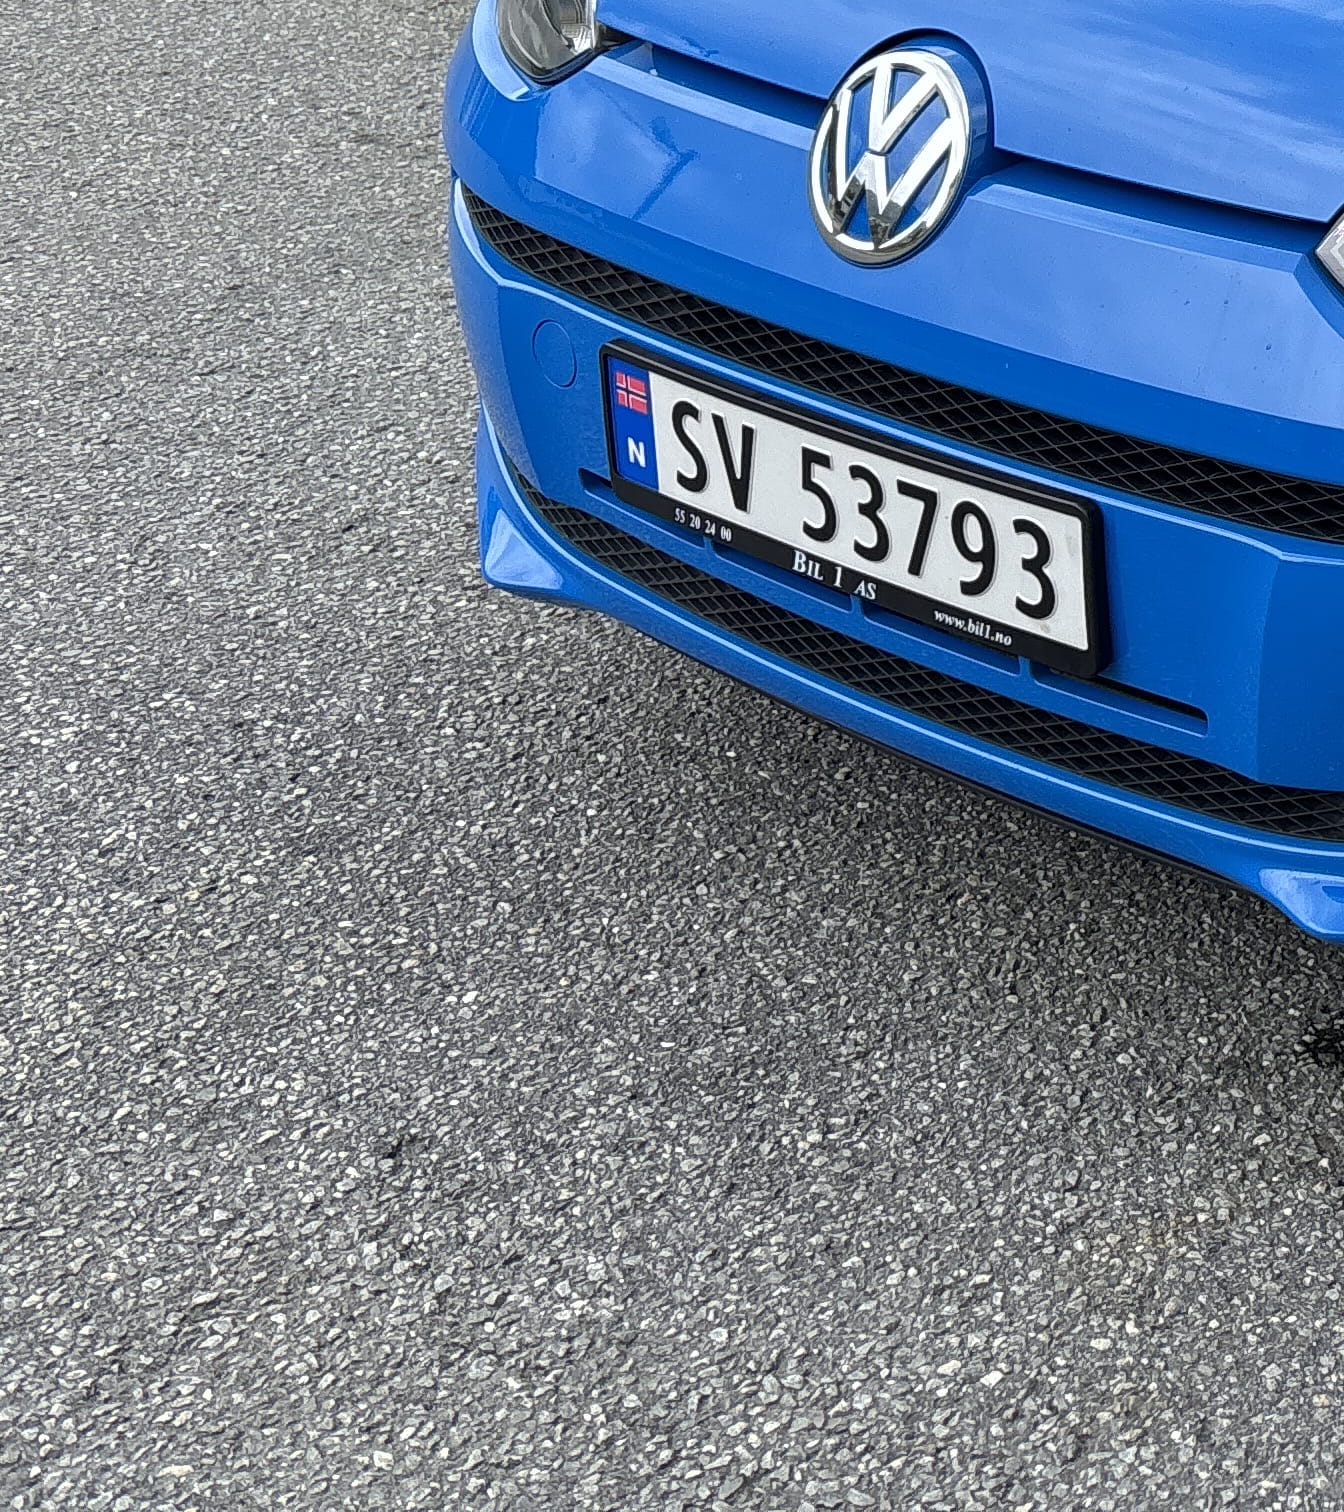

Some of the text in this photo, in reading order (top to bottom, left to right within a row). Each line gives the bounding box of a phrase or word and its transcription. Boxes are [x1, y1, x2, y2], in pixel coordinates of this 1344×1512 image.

[628, 436, 646, 468] N
[671, 399, 1056, 620] SV 53793
[674, 507, 732, 542] 55 20 24 00
[833, 565, 843, 588] 1
[854, 579, 877, 601] AS
[933, 608, 1013, 646] www.bil1.no
